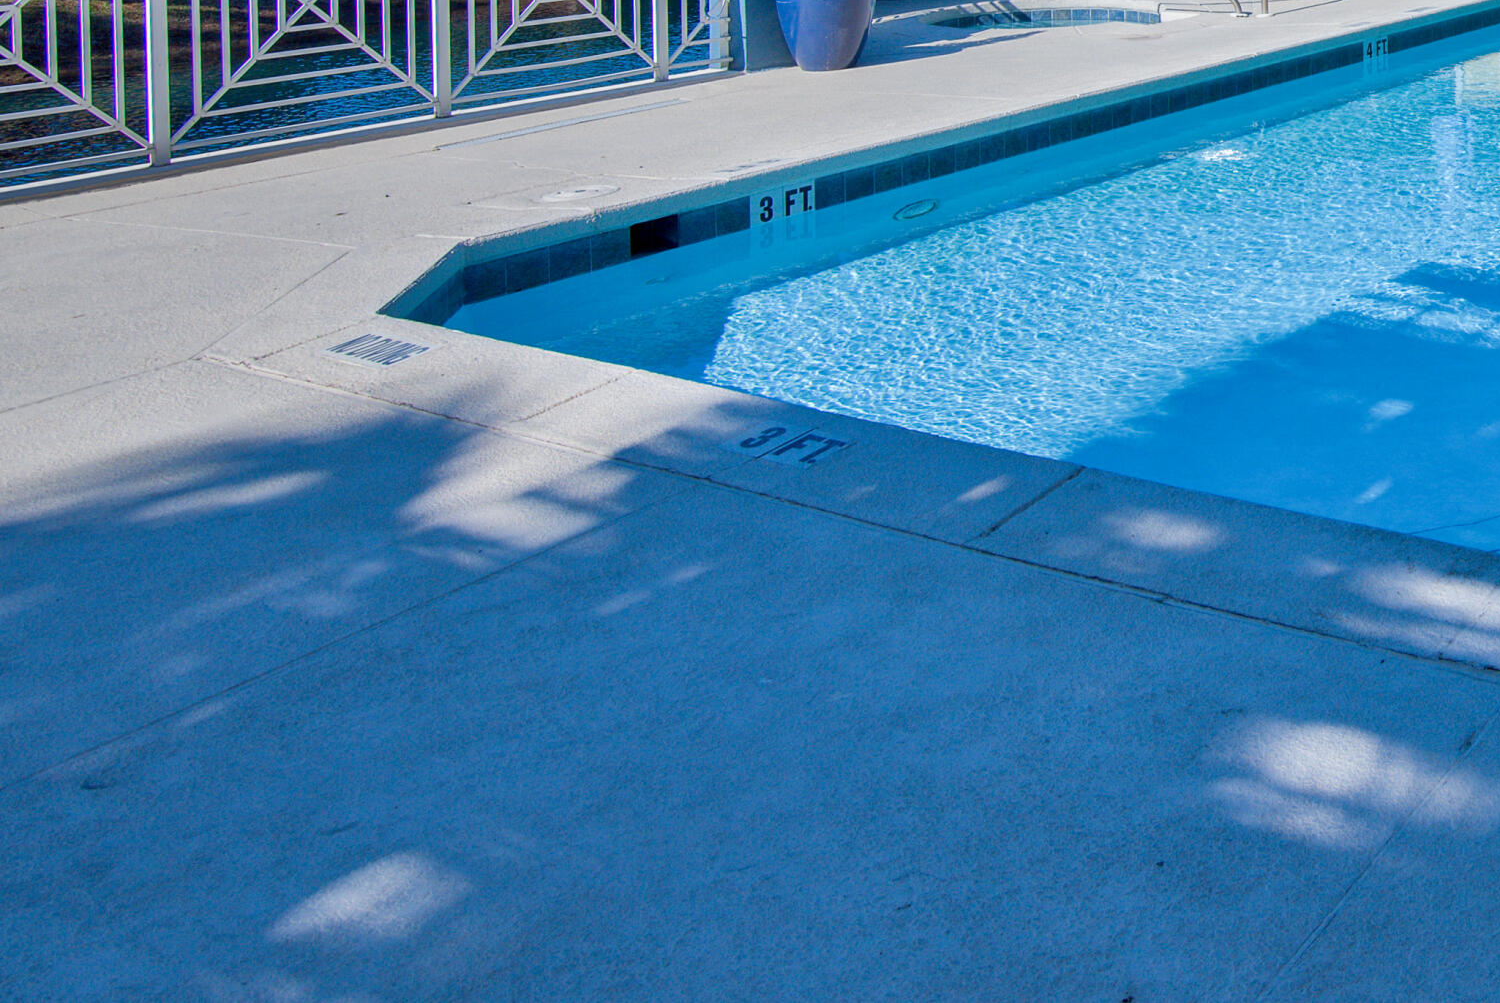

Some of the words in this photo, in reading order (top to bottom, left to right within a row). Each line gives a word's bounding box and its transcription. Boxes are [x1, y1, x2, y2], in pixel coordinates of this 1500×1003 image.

[1366, 42, 1373, 58] 4
[760, 196, 773, 223] 3
[740, 427, 787, 448] 3
